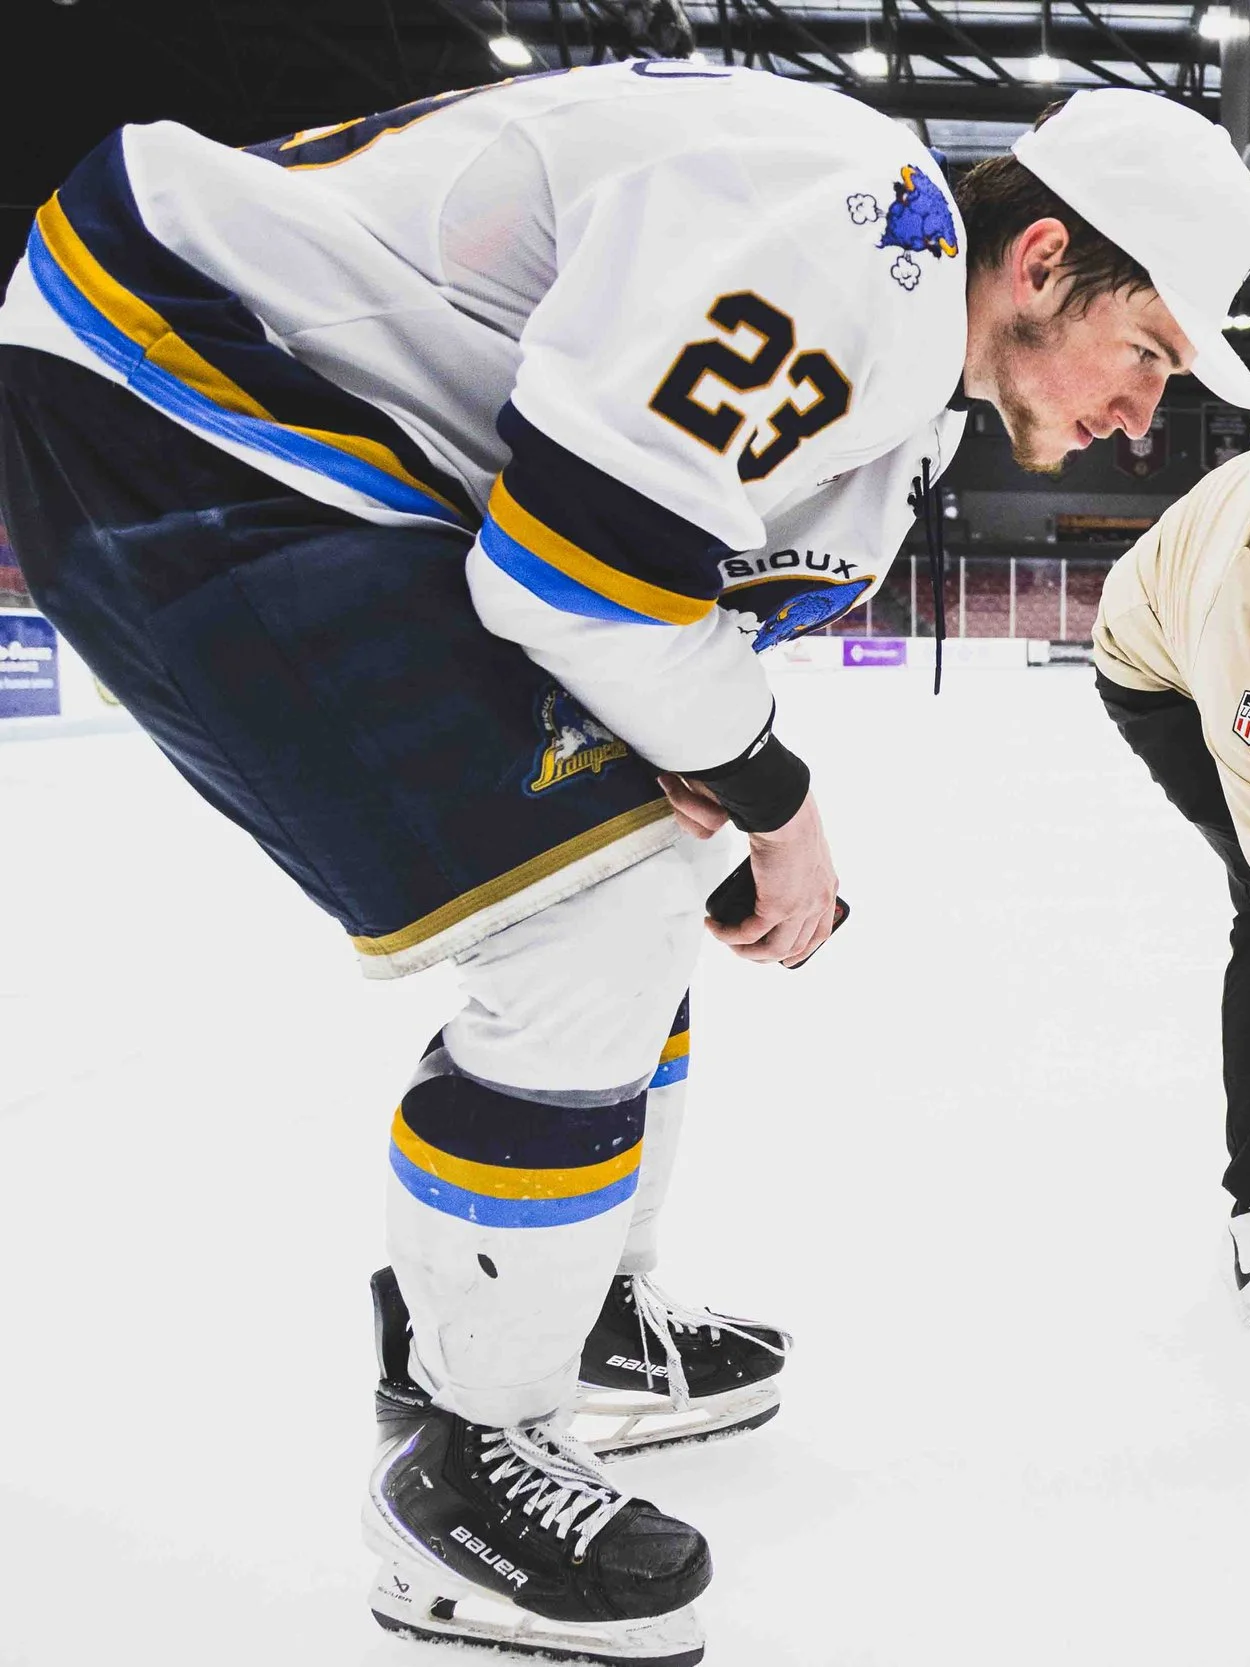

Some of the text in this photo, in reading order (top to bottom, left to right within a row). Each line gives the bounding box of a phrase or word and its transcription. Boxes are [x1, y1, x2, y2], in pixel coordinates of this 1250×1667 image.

[648, 289, 853, 484] 23
[724, 549, 858, 579] SIOUX
[606, 1354, 669, 1379] BAUE
[450, 1525, 529, 1588] BAUER
